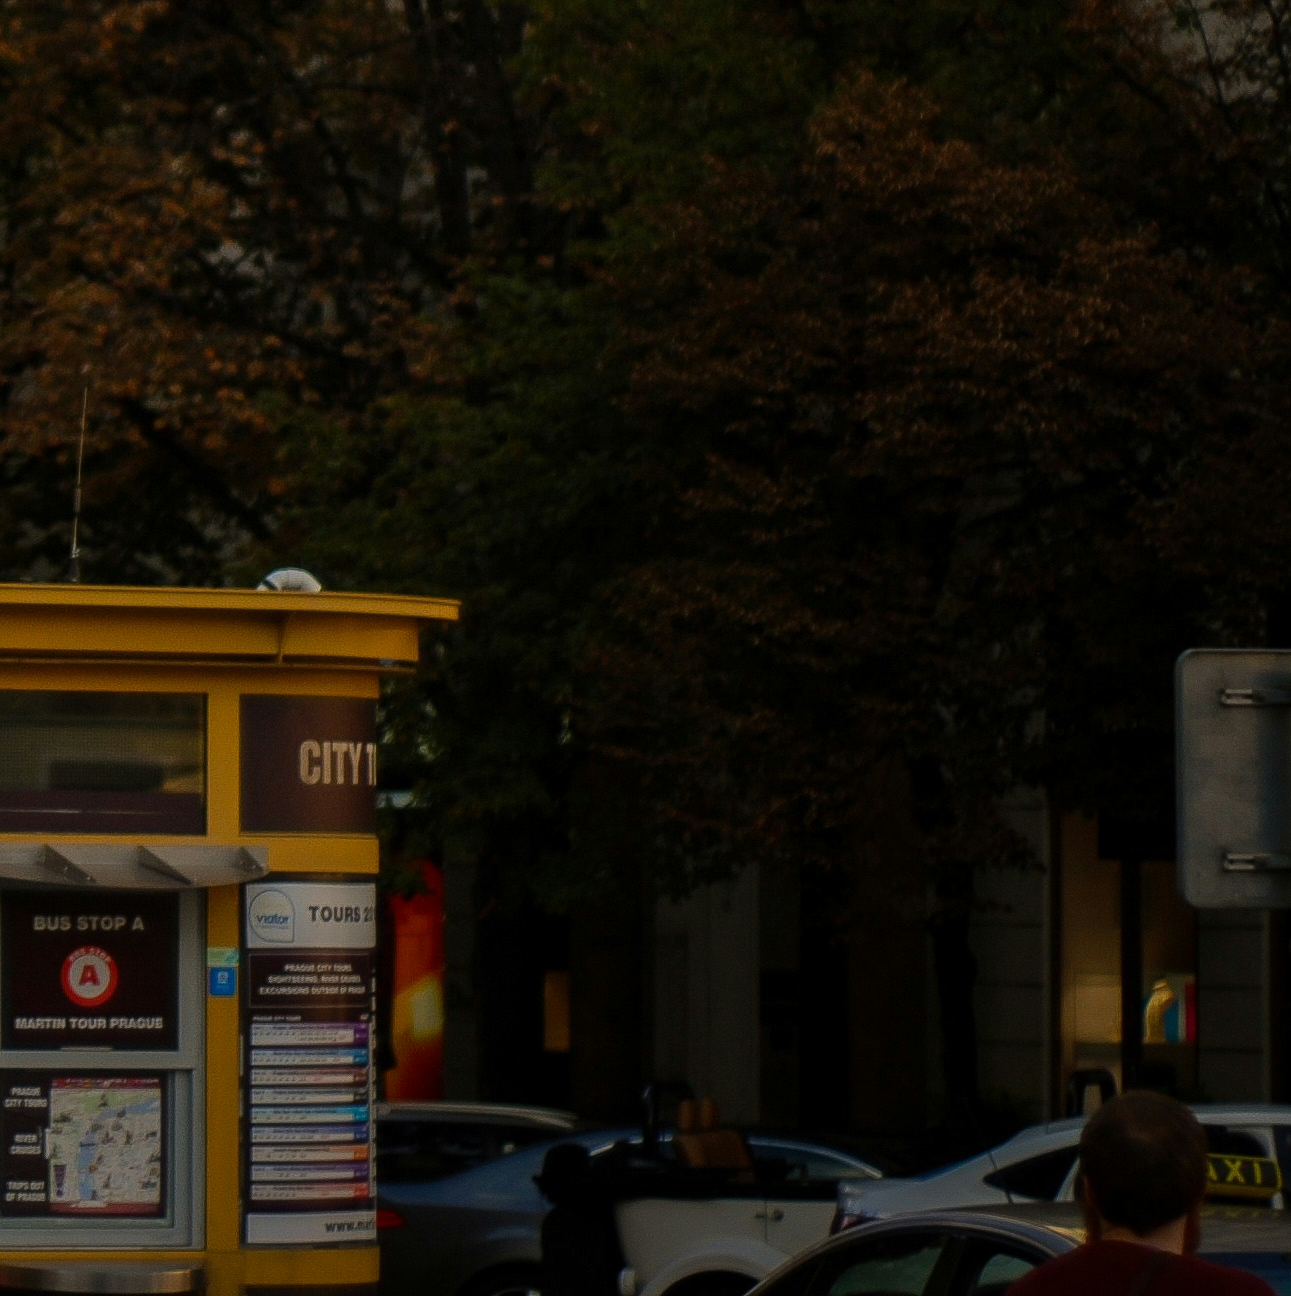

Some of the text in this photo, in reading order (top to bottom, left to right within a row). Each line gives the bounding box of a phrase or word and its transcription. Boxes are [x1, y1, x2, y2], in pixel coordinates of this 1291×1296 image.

[299, 739, 362, 785] CITY
[34, 915, 145, 931] BUS STOP A
[309, 905, 360, 923] TOURS
[79, 964, 100, 985] A
[15, 1017, 163, 1030] MARTIN TOUR PRAGUE
[1206, 1159, 1262, 1185] AXI
